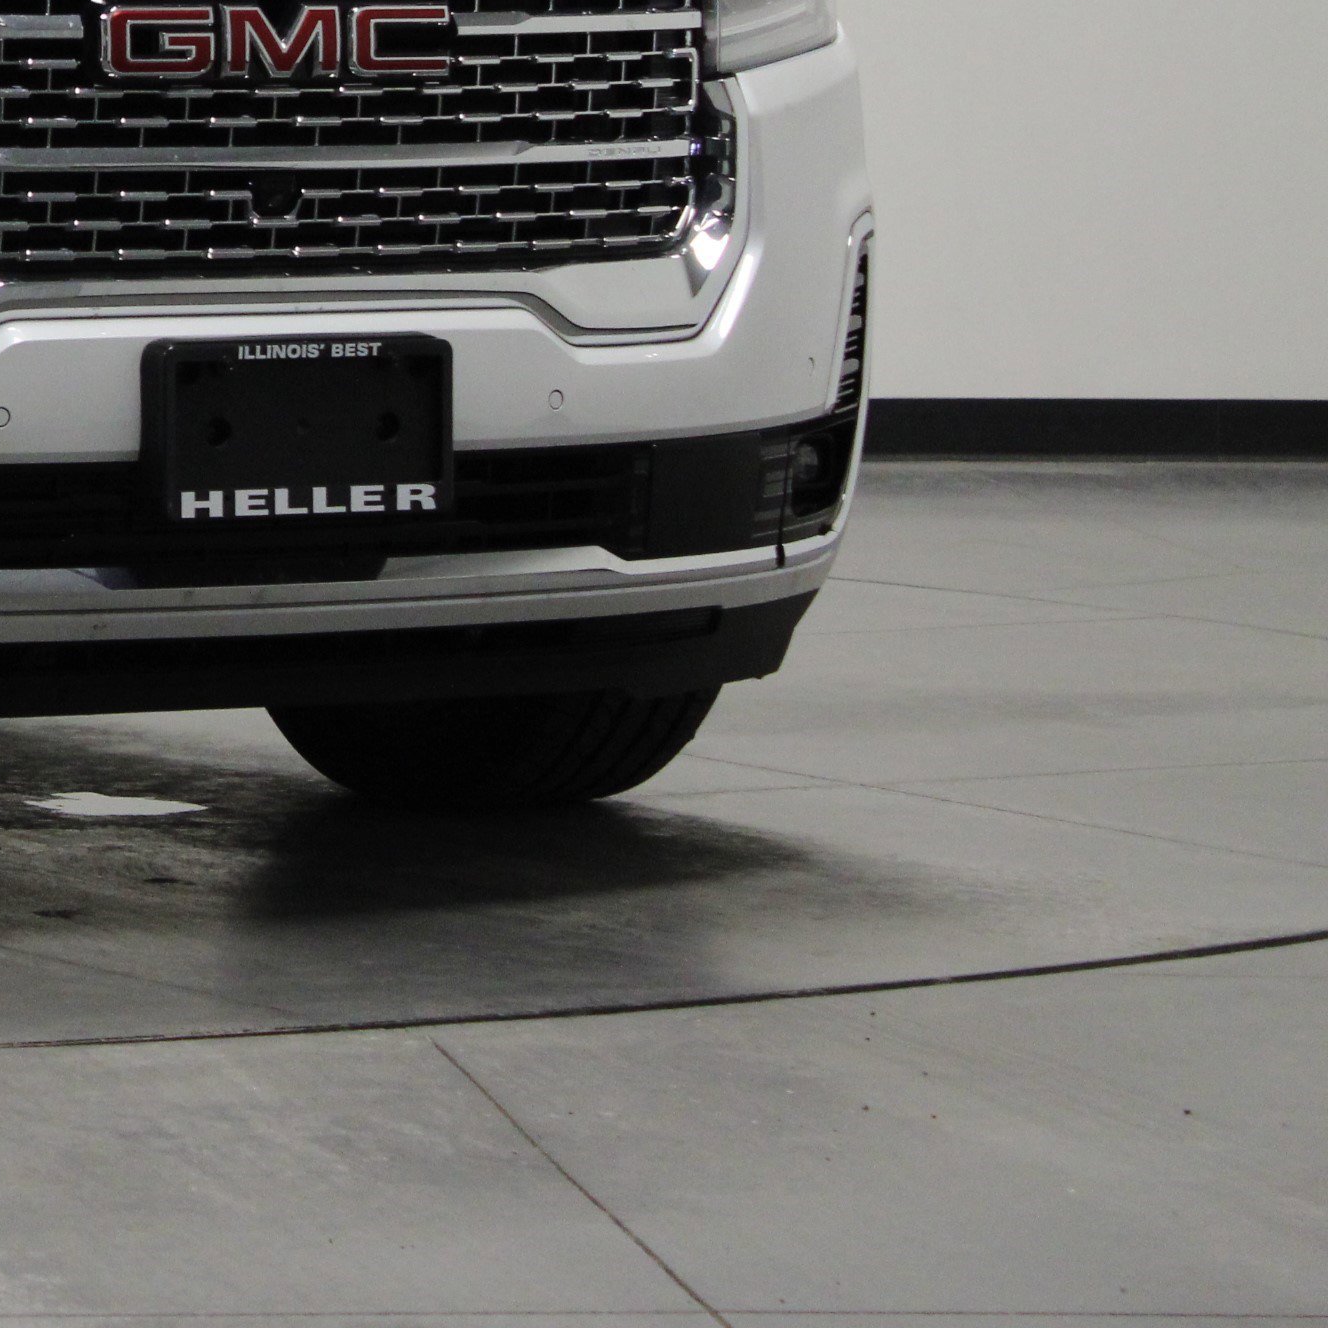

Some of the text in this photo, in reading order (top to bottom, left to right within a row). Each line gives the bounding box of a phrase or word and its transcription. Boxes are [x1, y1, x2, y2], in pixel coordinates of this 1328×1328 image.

[102, 5, 449, 78] GMC
[238, 342, 382, 360] ILLINOIS' BEST
[181, 483, 436, 519] HELLER
